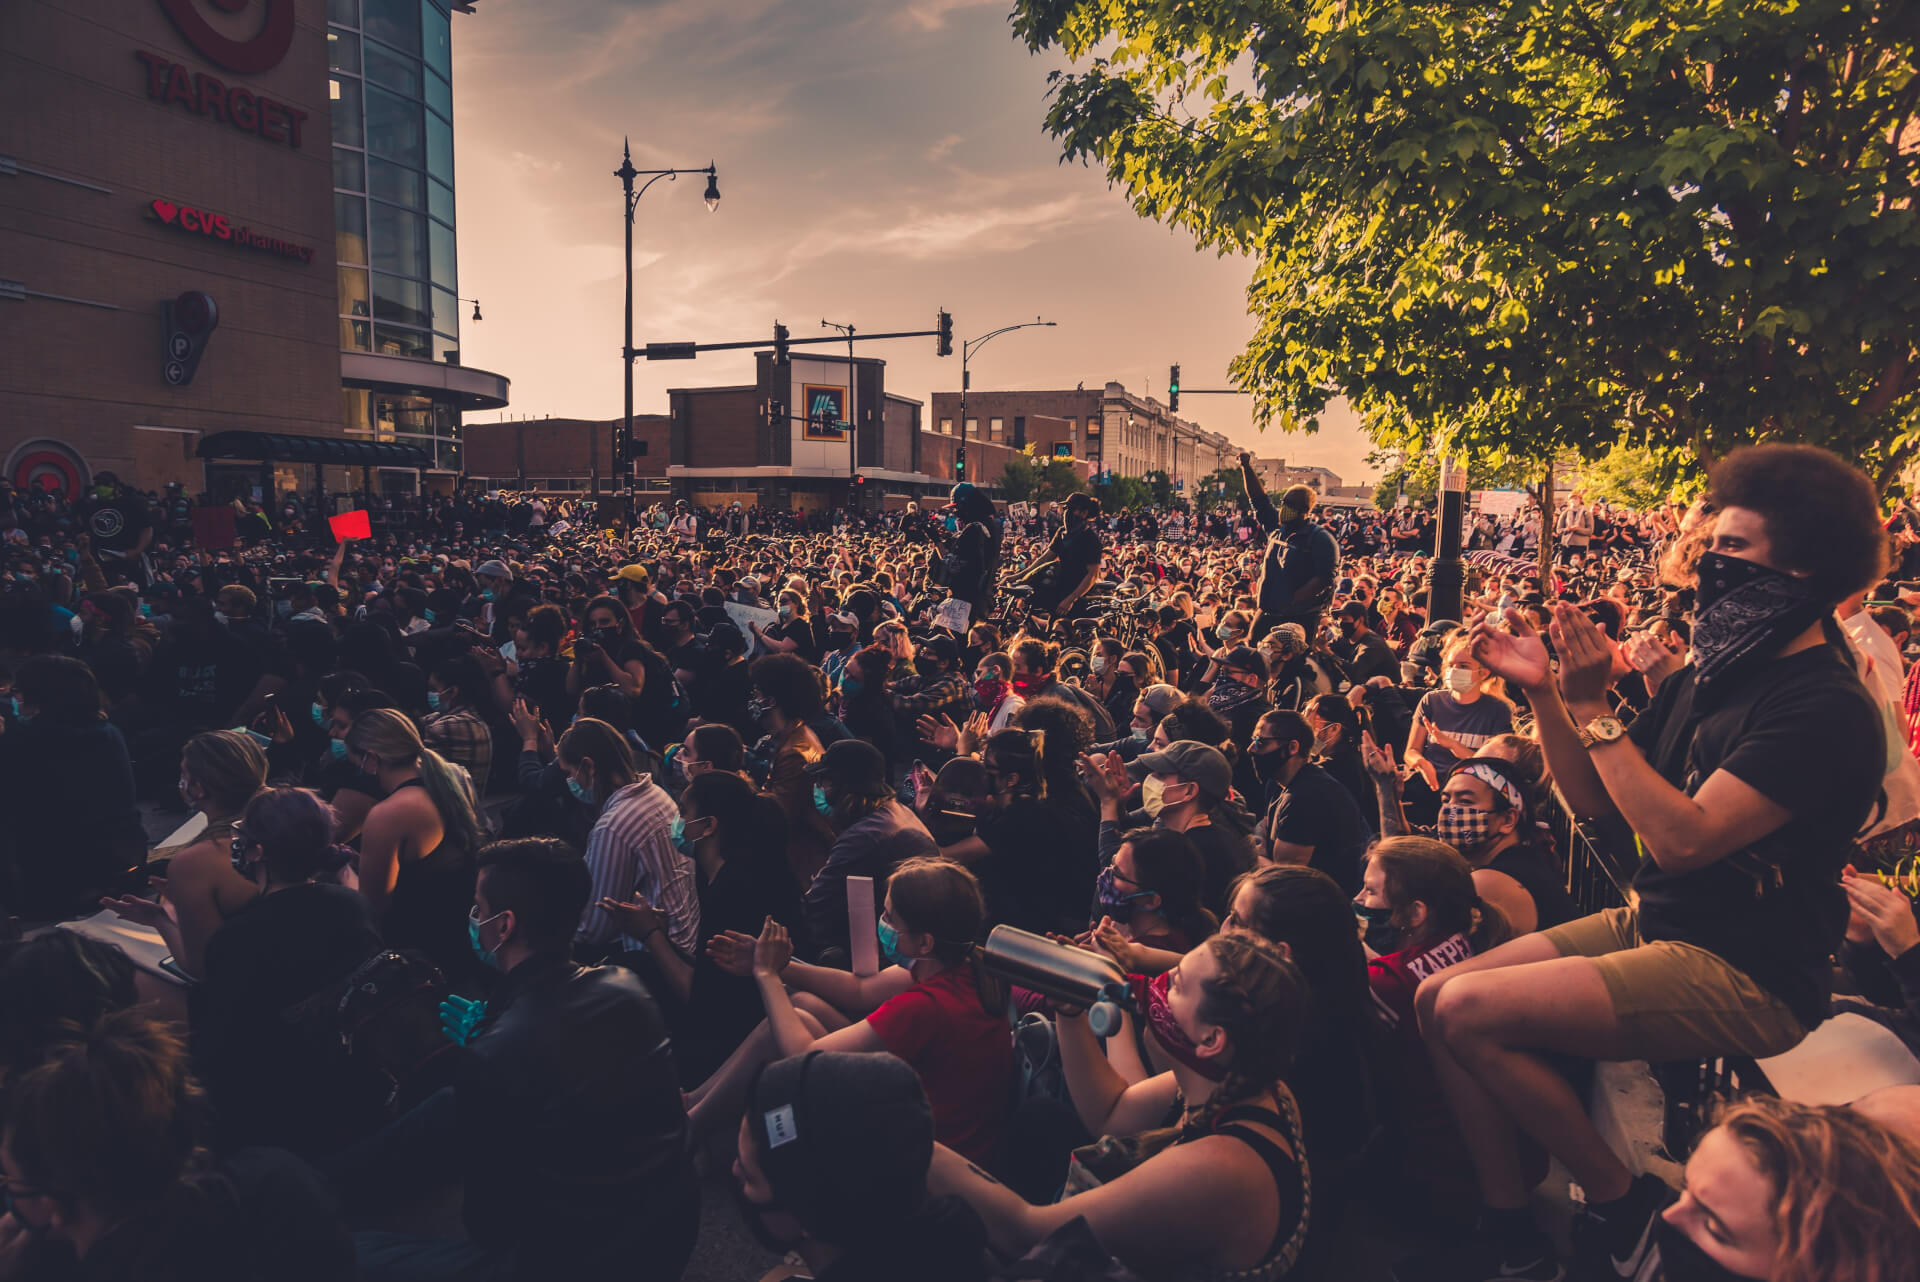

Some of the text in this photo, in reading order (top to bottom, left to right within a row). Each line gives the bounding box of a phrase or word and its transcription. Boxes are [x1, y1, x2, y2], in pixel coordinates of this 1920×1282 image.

[136, 50, 308, 148] TARGET
[179, 206, 316, 265] CVS pharmacy
[175, 338, 188, 355] P
